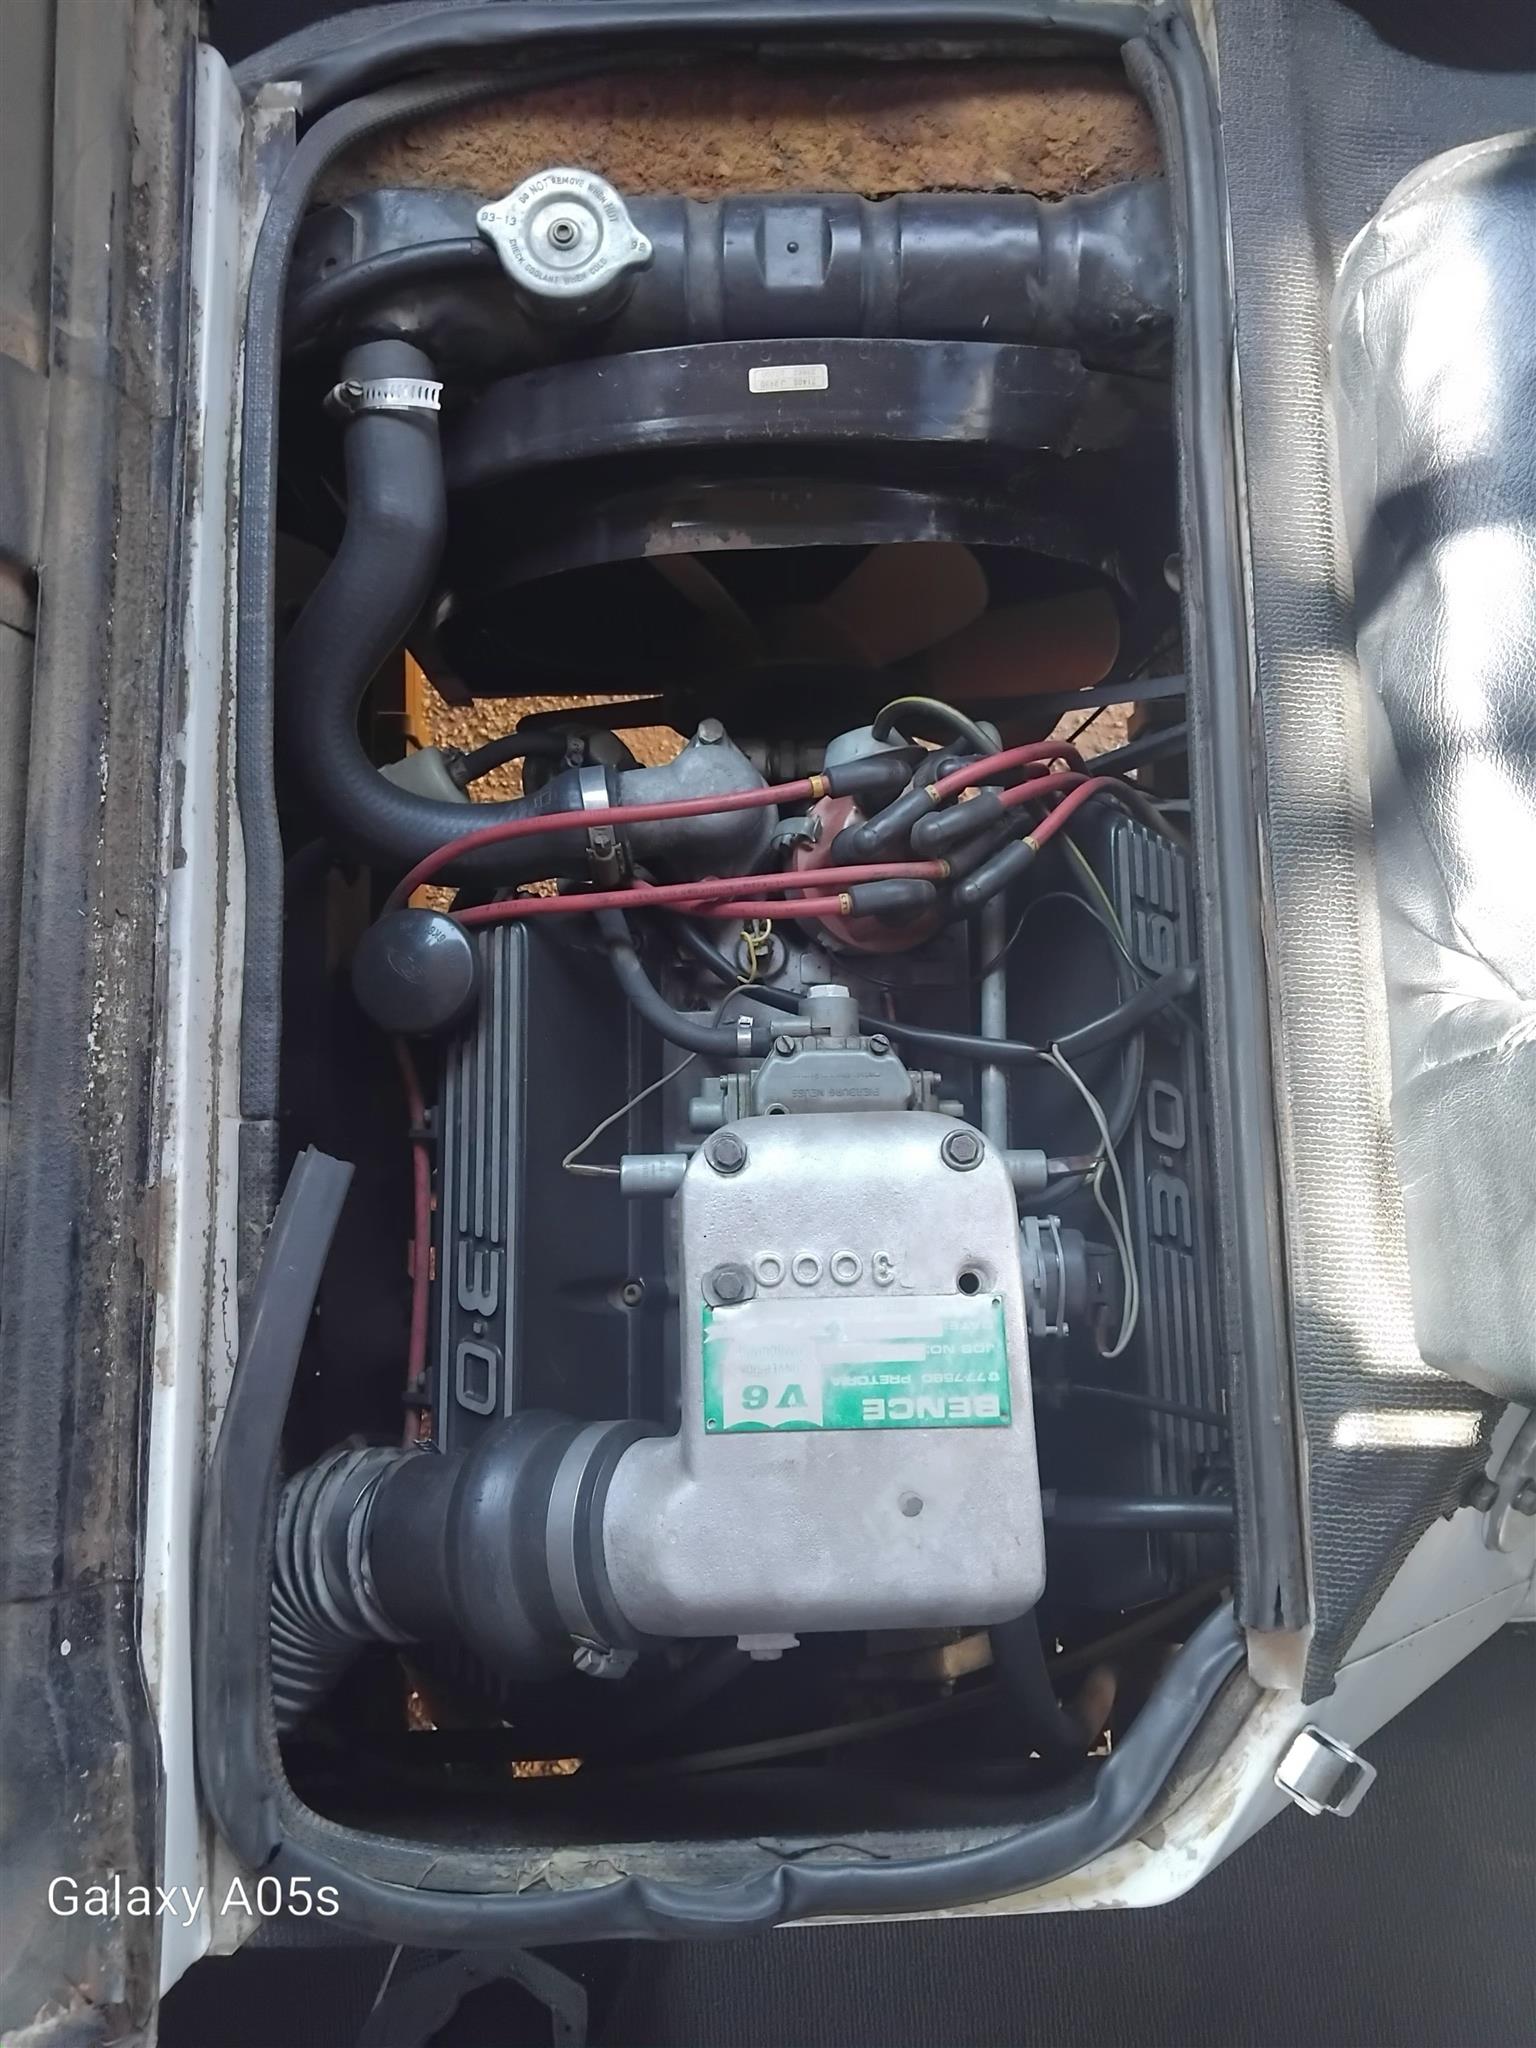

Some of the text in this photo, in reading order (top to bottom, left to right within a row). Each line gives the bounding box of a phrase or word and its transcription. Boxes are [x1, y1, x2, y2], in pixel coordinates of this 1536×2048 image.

[529, 176, 550, 195] NOT
[551, 176, 585, 188] REMOVE
[509, 238, 524, 265] CHECK
[525, 263, 559, 284] COOLANT
[564, 273, 587, 285] WHEN
[753, 1250, 895, 1287] 3000
[831, 1374, 912, 1386] PRETORIA
[863, 1396, 1001, 1422] BENCE
